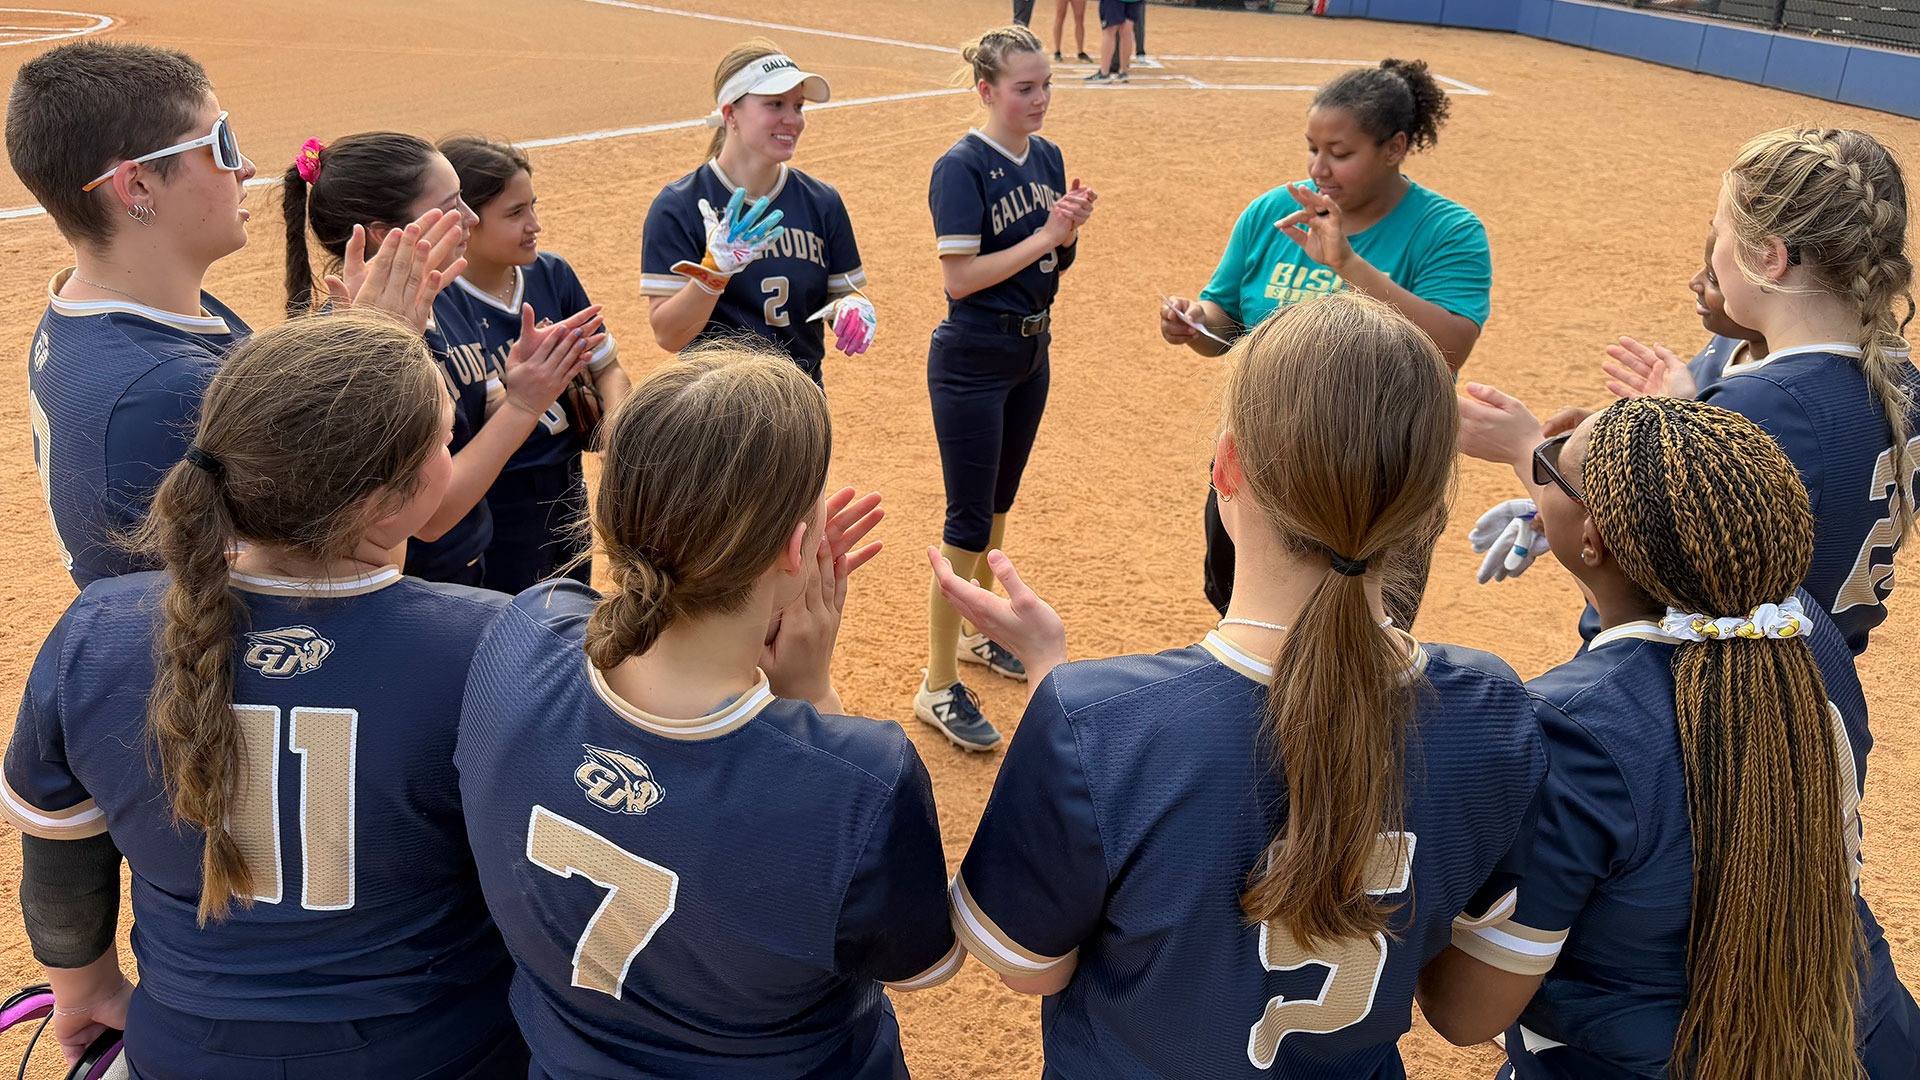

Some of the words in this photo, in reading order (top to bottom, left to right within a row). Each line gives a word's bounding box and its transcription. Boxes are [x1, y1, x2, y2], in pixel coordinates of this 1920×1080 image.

[754, 227, 827, 269] AUDET
[761, 276, 790, 327] 2
[227, 703, 359, 911] 11
[527, 804, 679, 1000] 7
